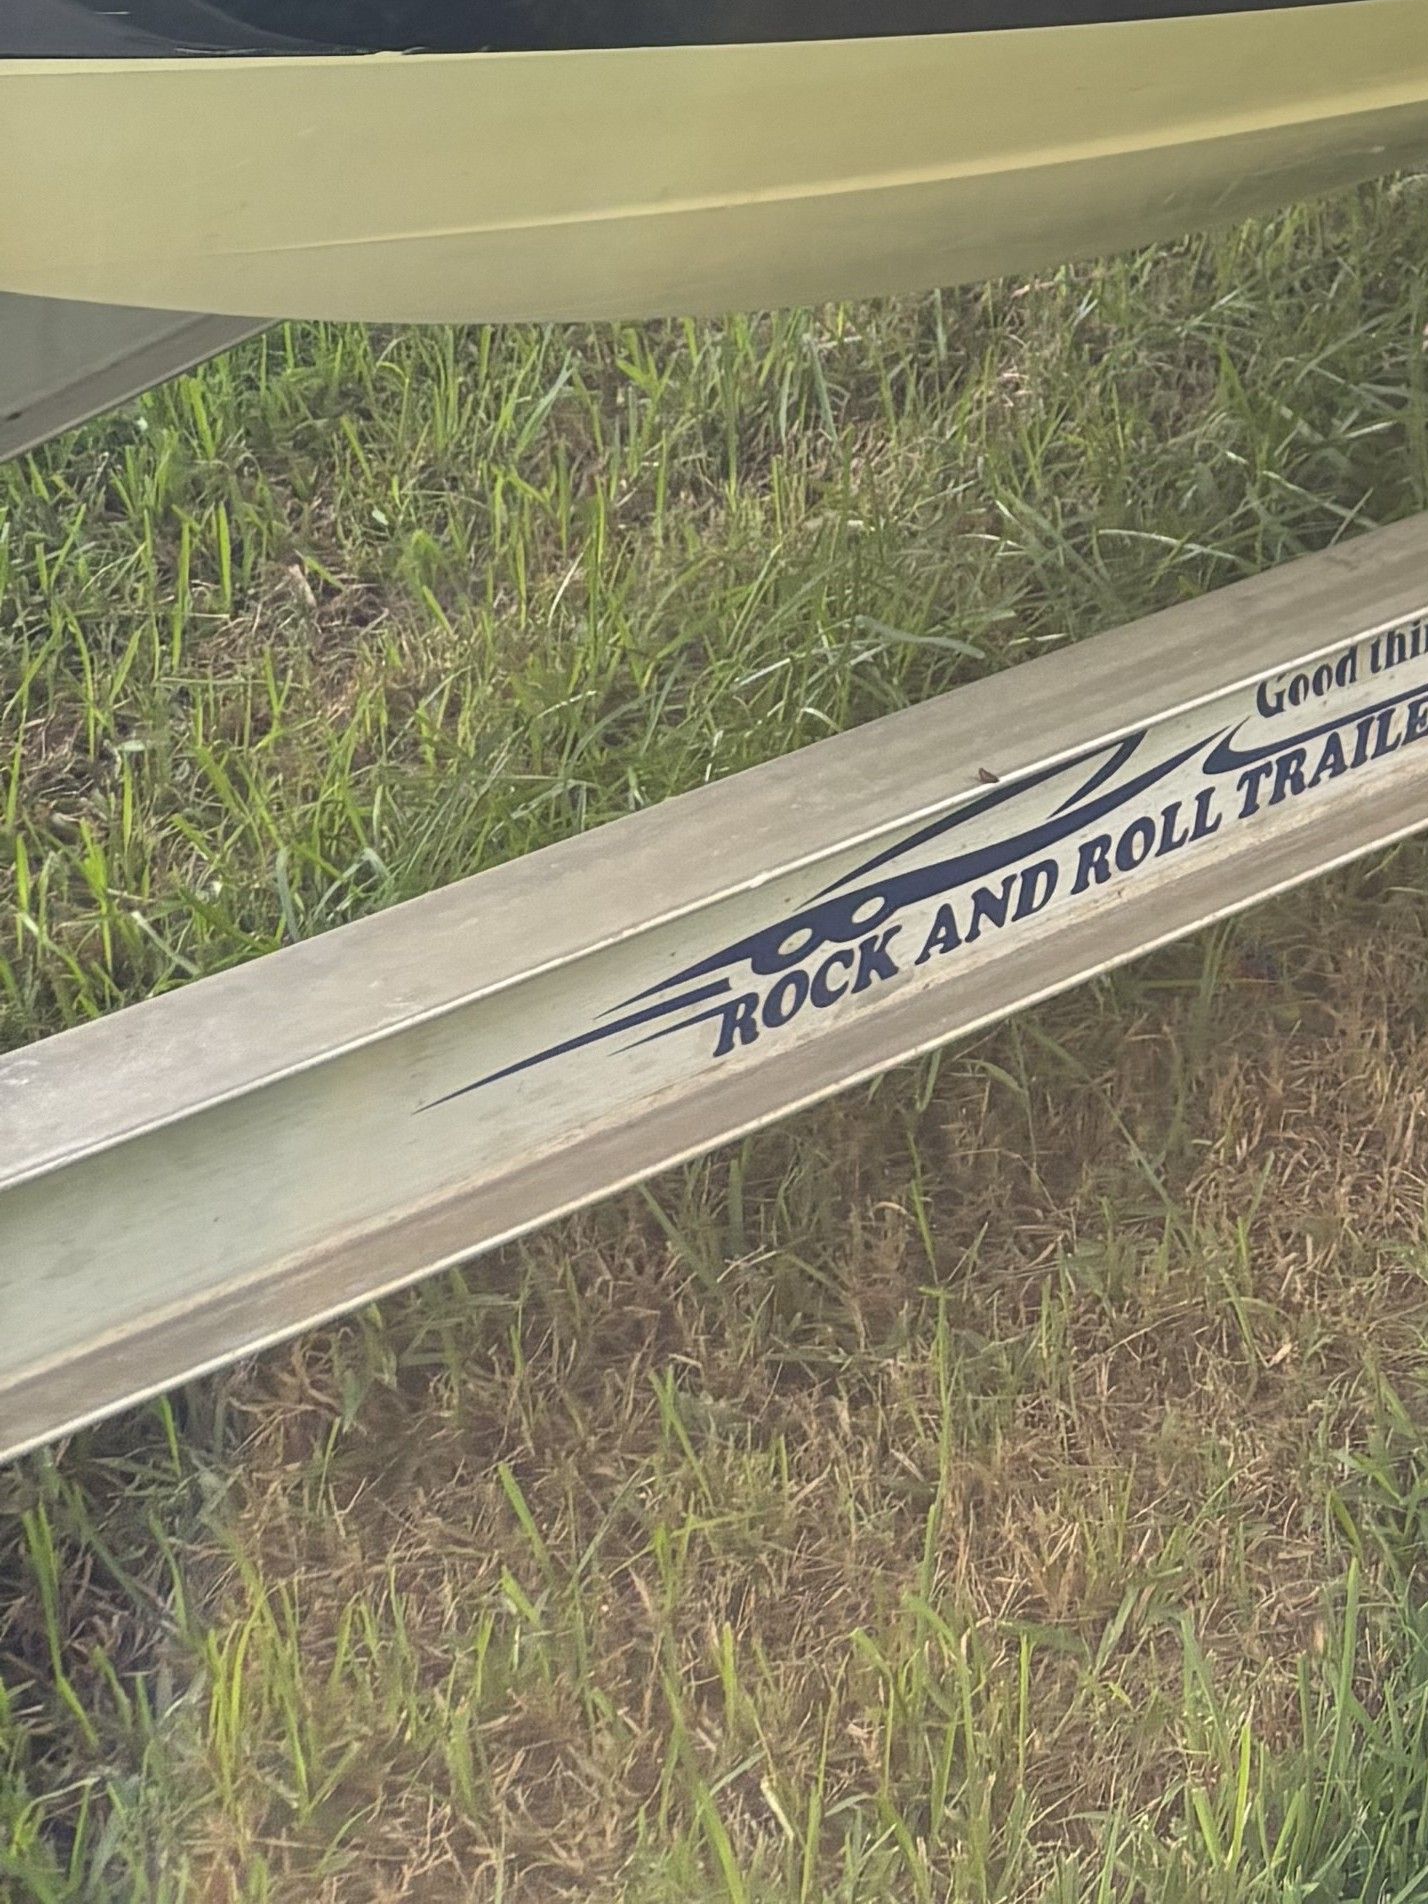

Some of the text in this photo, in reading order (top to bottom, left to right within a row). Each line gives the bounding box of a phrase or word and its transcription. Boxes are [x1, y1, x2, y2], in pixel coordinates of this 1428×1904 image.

[1256, 645, 1357, 718] Good
[713, 924, 902, 1057] ROCK
[914, 858, 1059, 965] AND
[1070, 786, 1222, 895] ROLL
